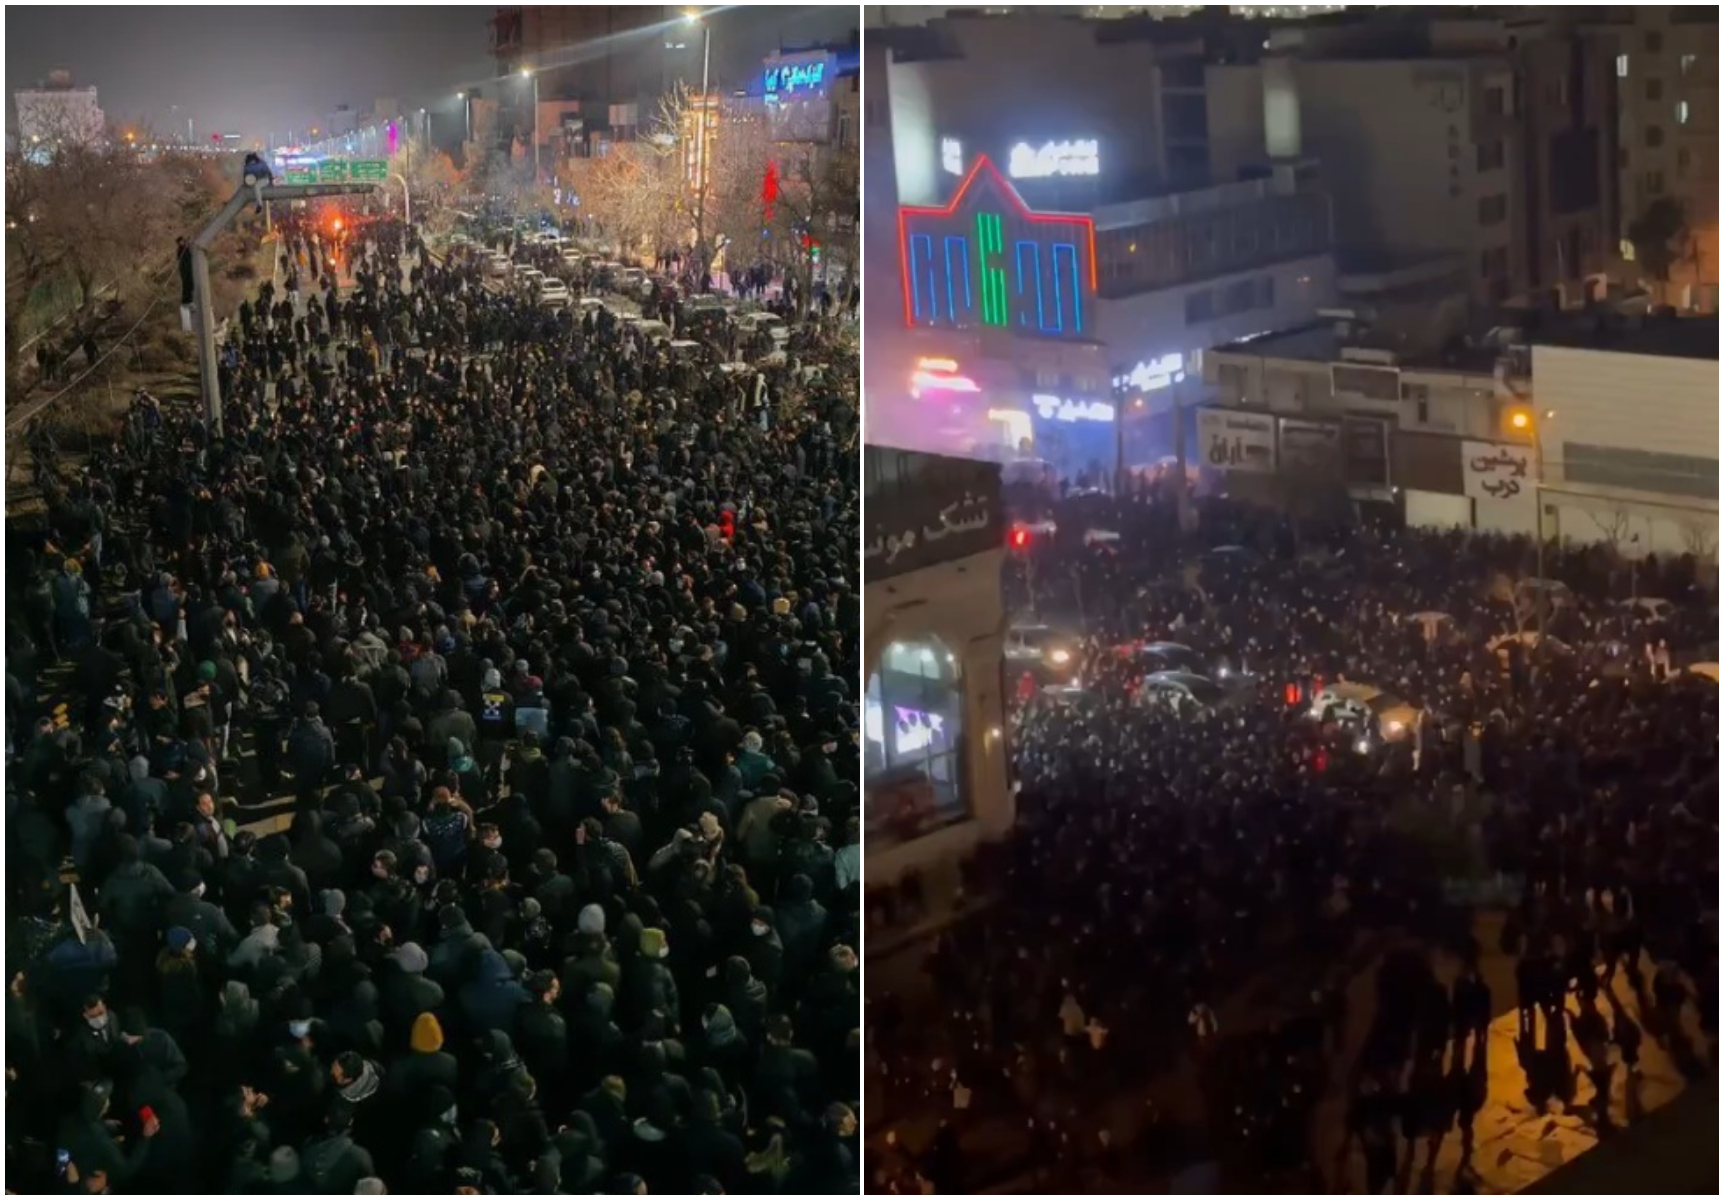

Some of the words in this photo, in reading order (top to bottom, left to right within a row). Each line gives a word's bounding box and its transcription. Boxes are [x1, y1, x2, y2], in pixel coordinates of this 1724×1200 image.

[1470, 448, 1528, 478] پرشین
[1481, 479, 1520, 499] درب
[922, 490, 989, 541] تشک
